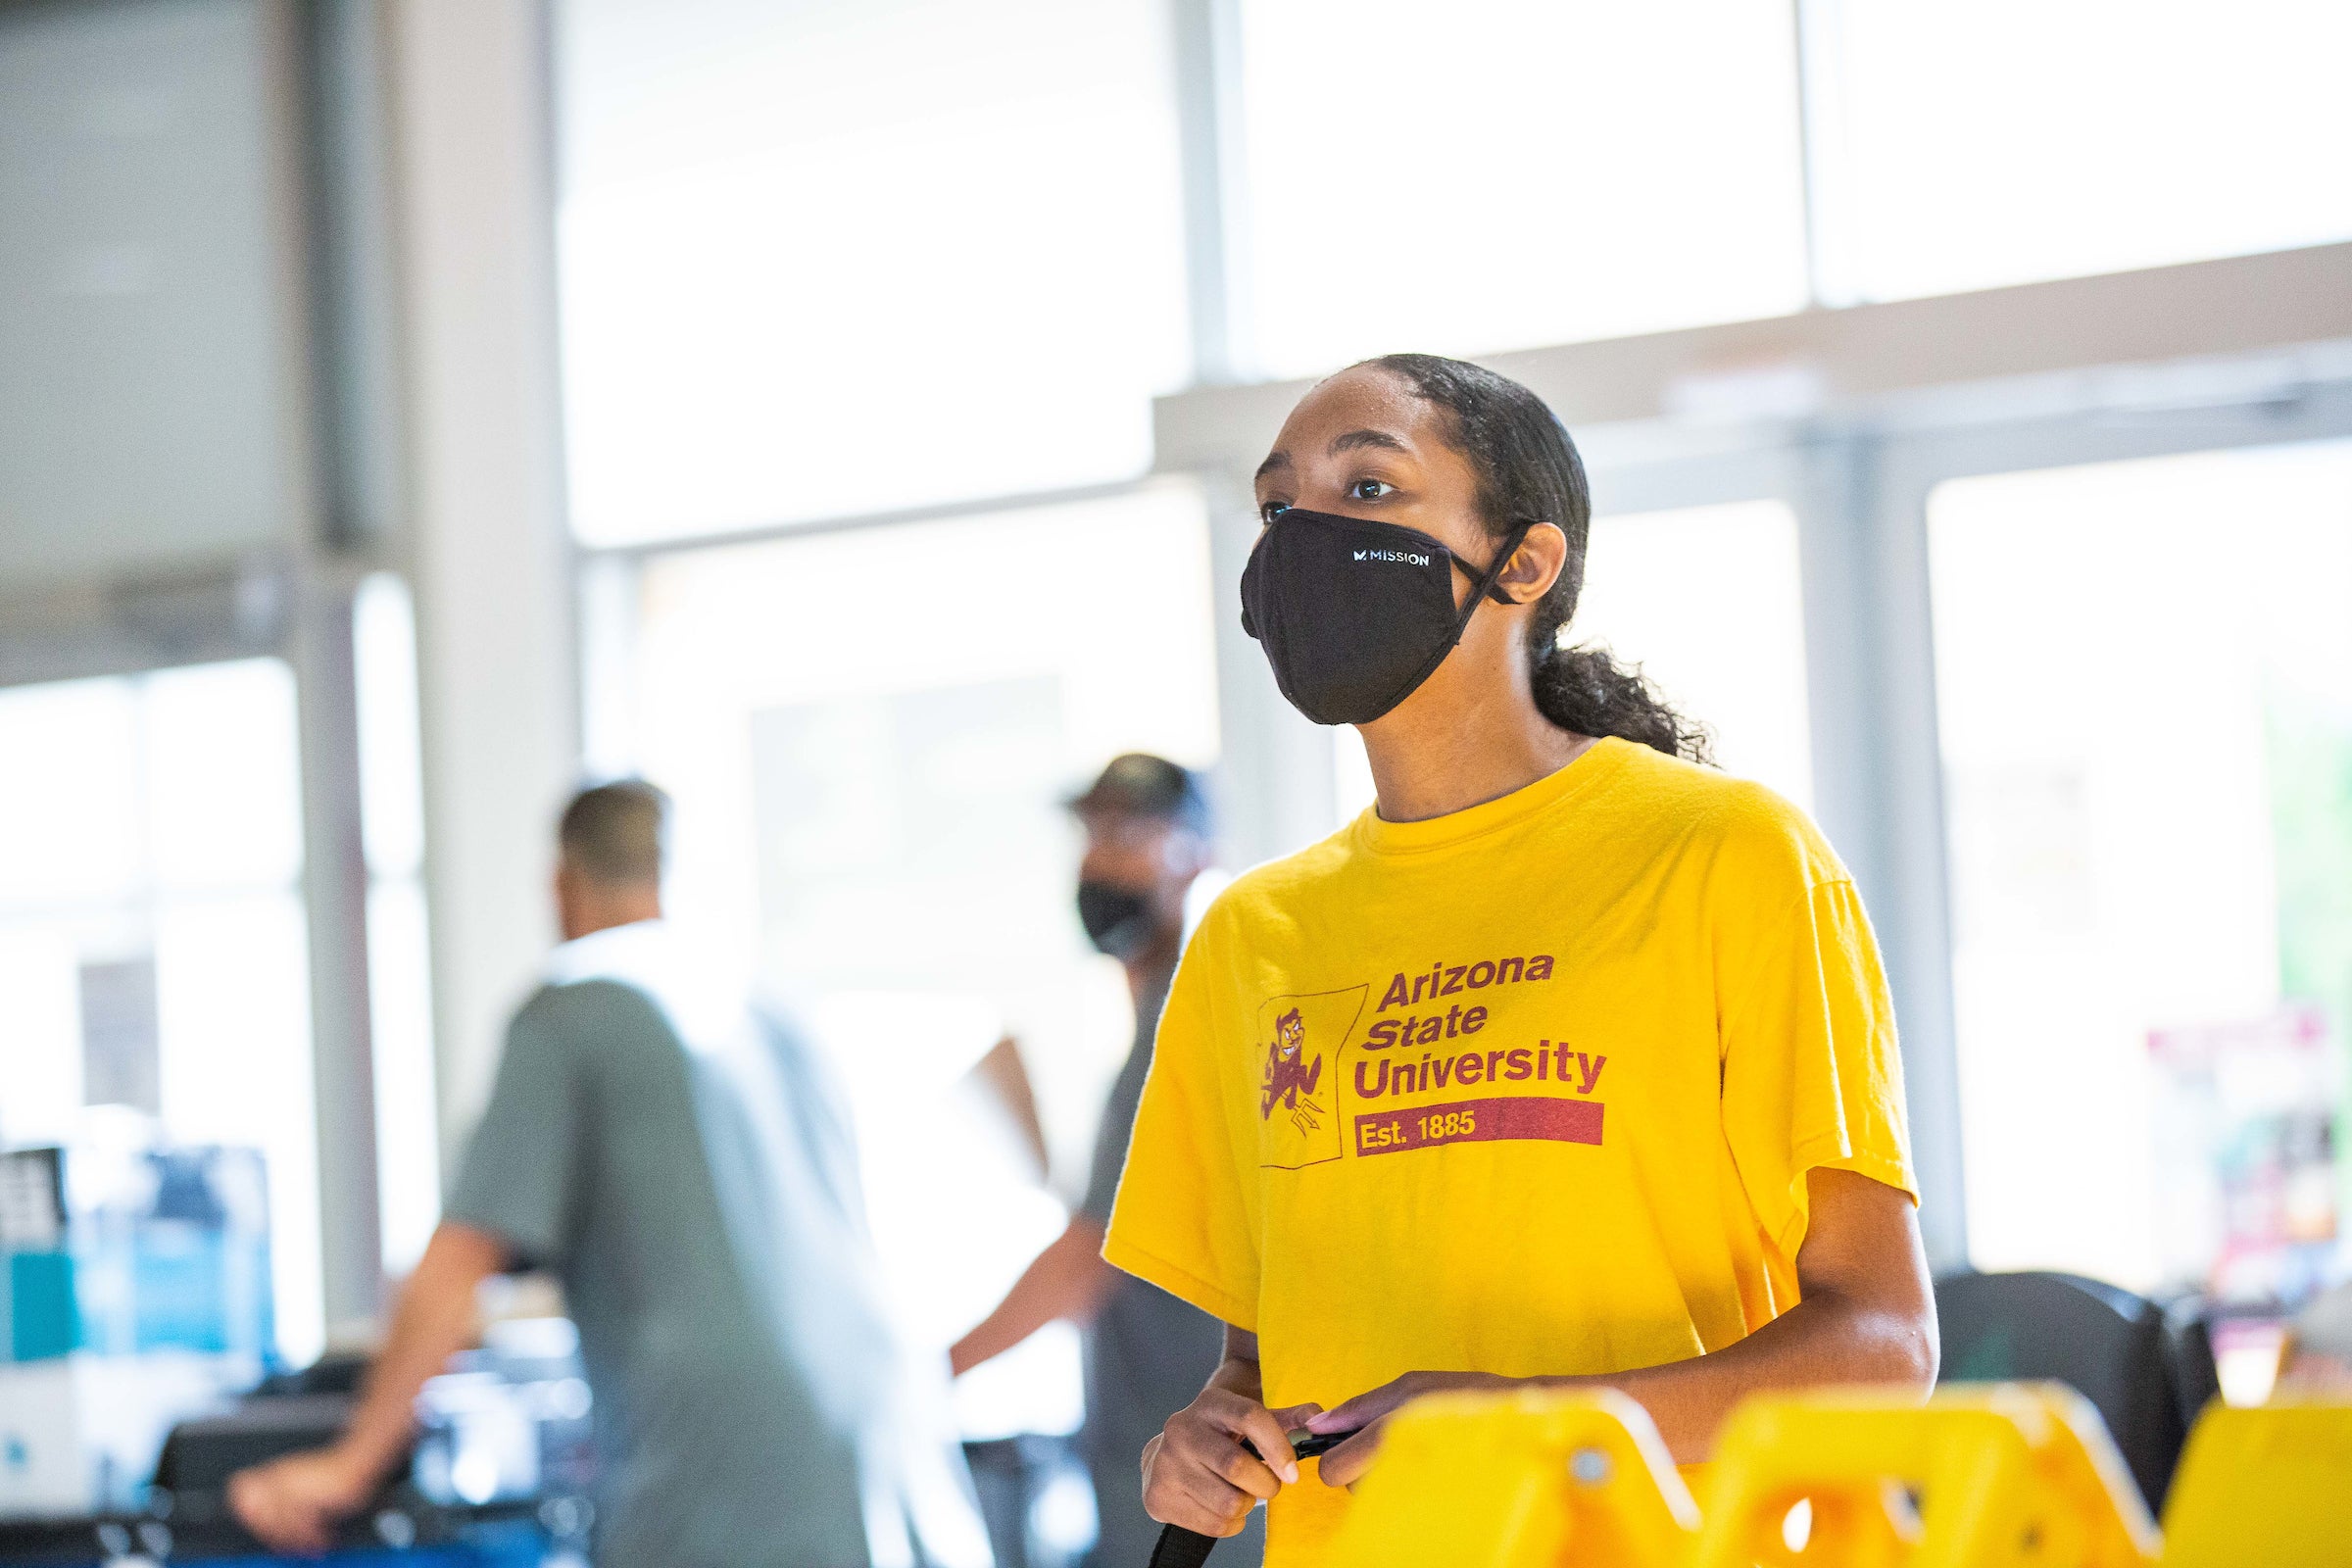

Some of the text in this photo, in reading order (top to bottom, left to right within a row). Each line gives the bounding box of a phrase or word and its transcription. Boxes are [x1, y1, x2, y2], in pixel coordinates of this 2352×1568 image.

[1370, 549, 1429, 565] MISSION
[1377, 955, 1554, 1012] Arizona
[1362, 1004, 1488, 1051] State
[1354, 1040, 1607, 1099] University
[1360, 1110, 1476, 1150] Est. 1885
